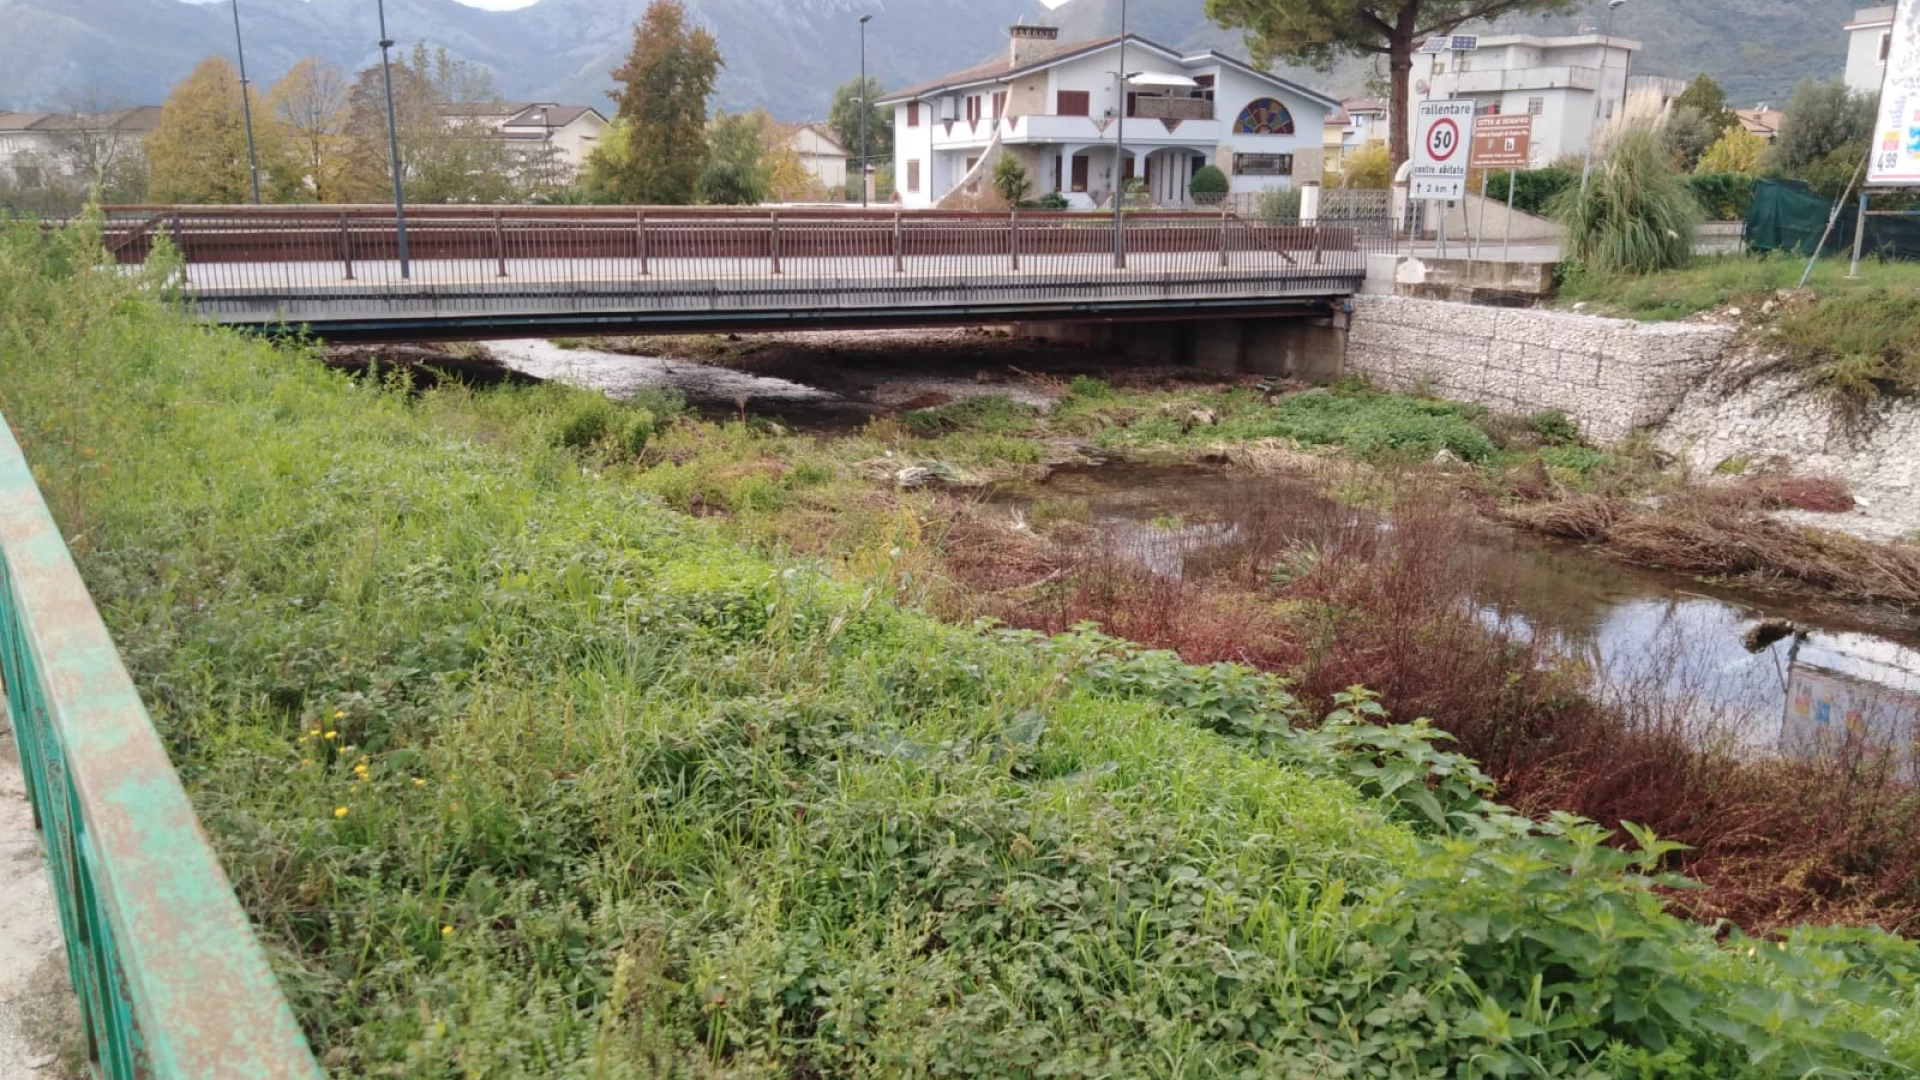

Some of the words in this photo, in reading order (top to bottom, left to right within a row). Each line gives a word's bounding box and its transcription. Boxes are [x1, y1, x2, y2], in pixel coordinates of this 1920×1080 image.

[1421, 103, 1471, 115] rallentare
[1433, 130, 1452, 149] 50
[1414, 165, 1435, 174] centro
[1439, 165, 1464, 174] abitato
[1426, 184, 1431, 192] 2
[1435, 184, 1447, 193] km
